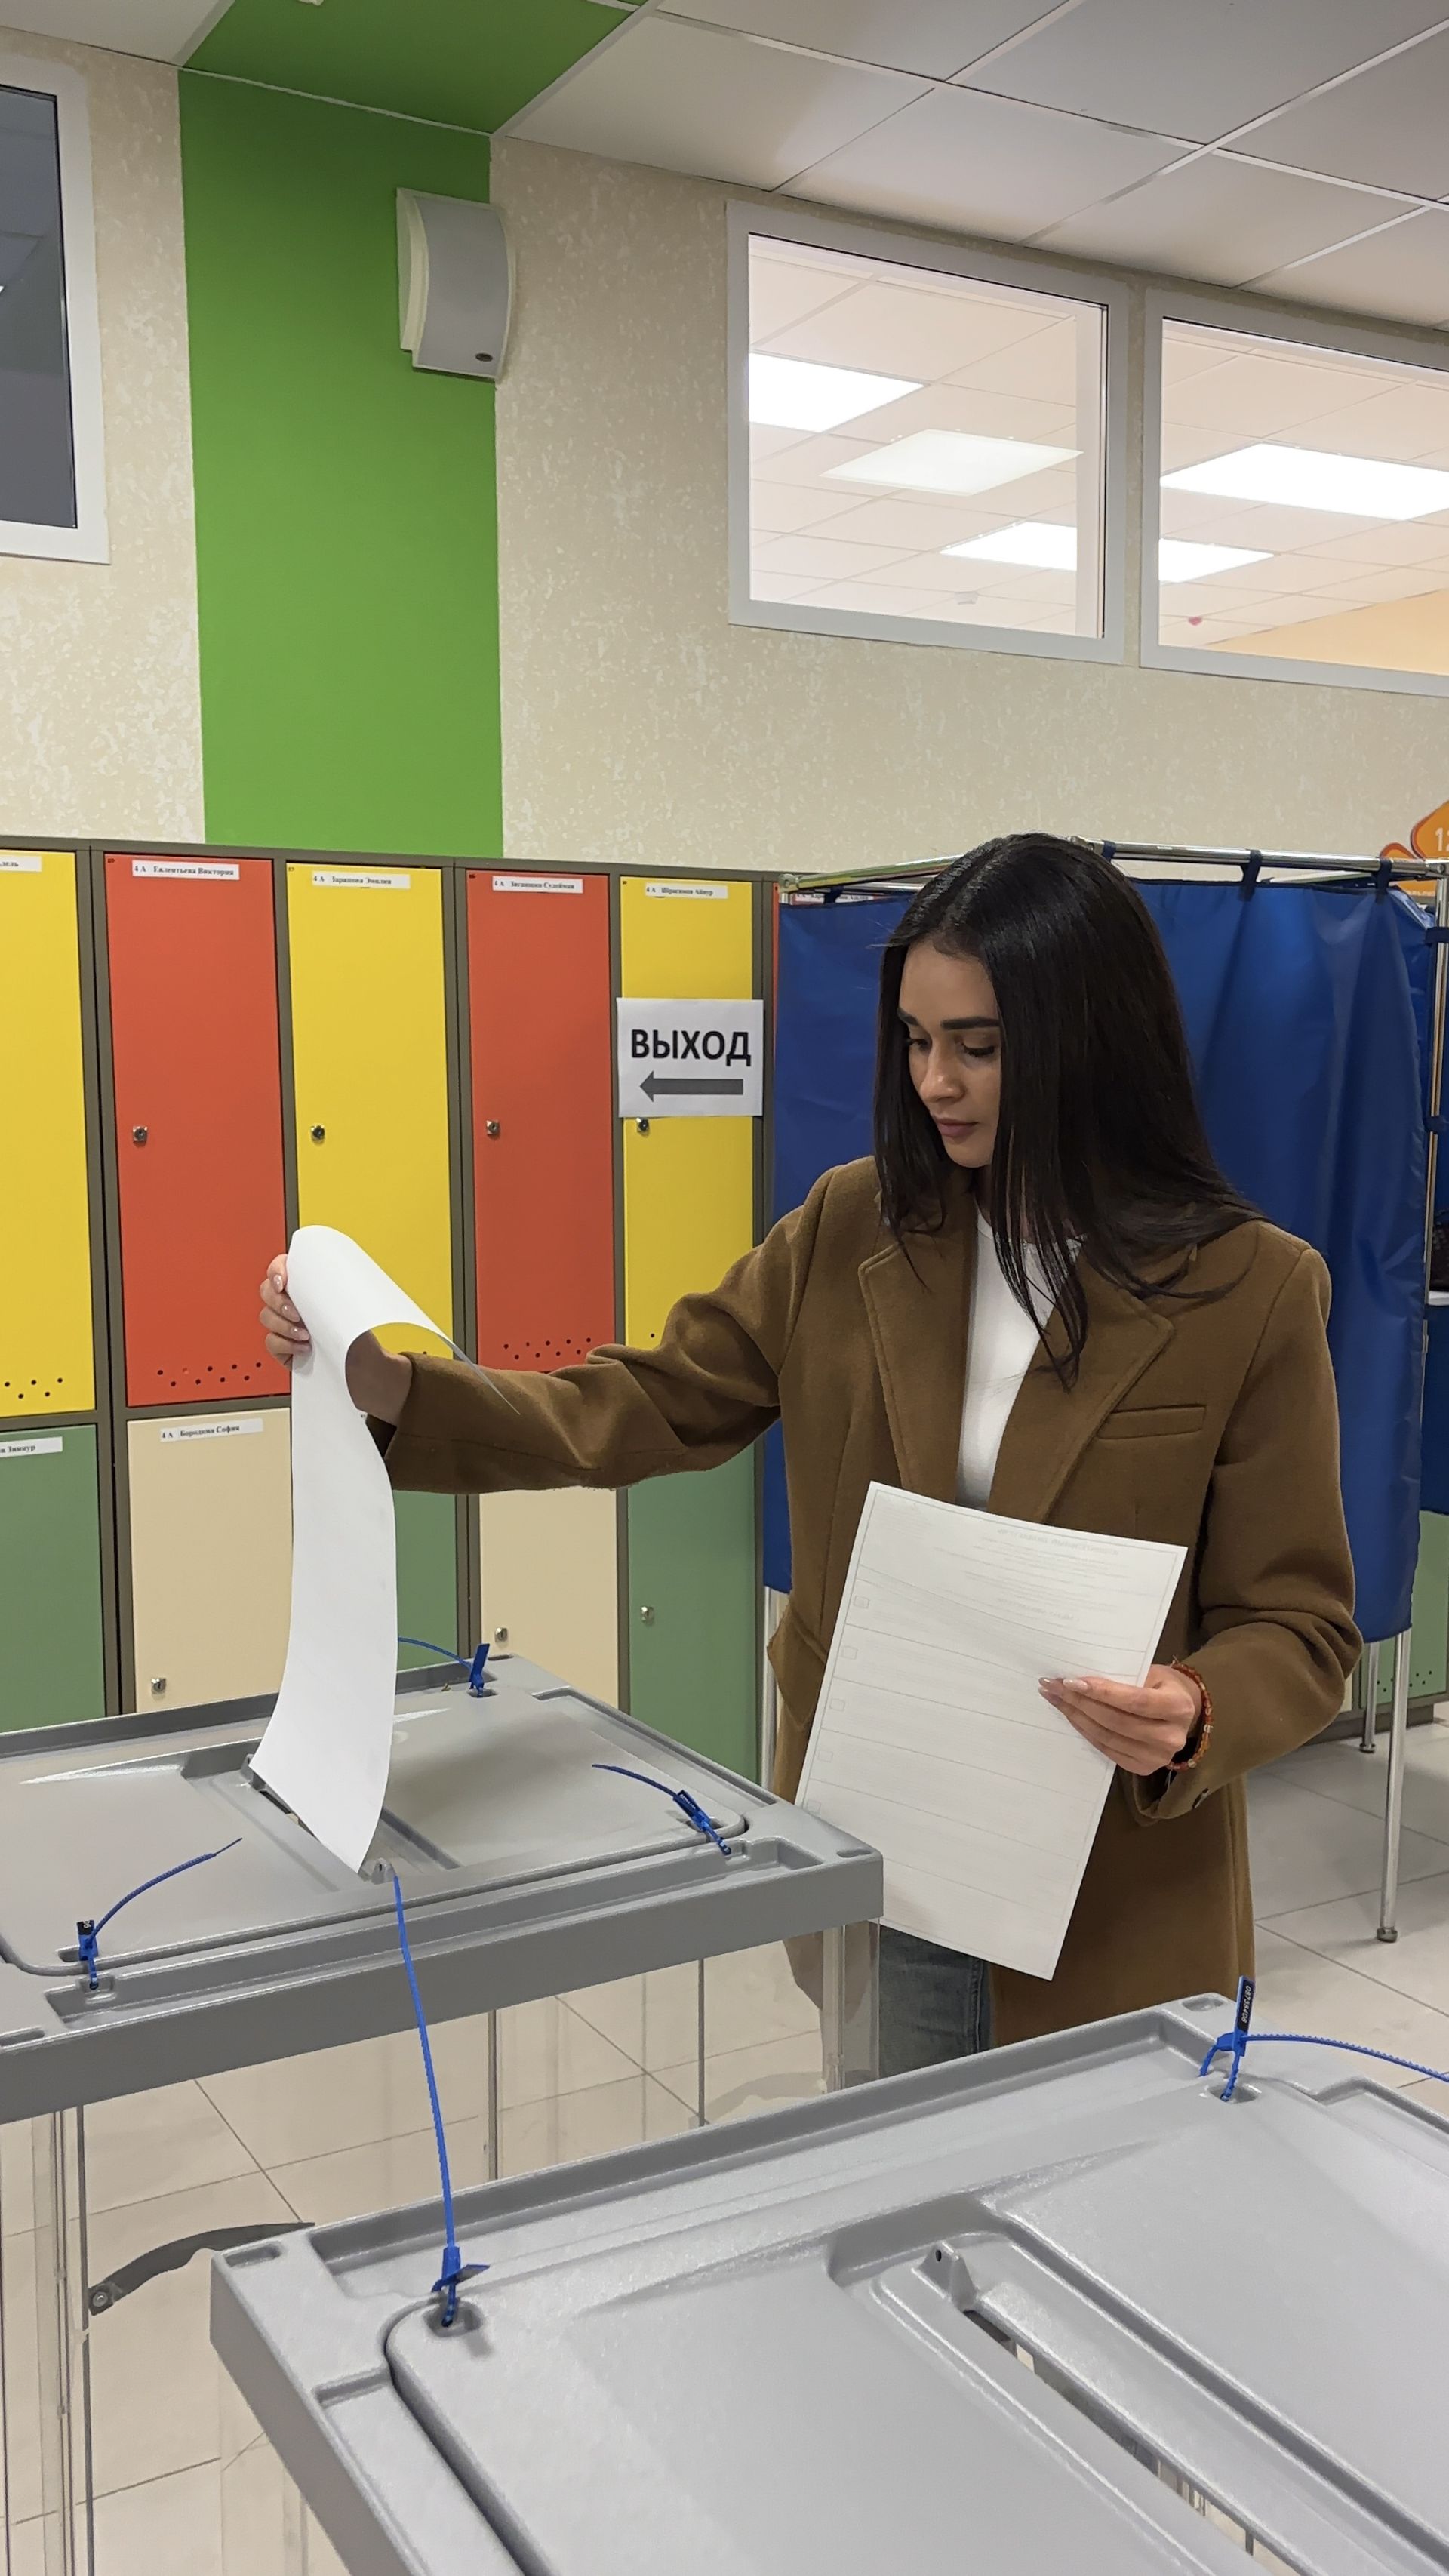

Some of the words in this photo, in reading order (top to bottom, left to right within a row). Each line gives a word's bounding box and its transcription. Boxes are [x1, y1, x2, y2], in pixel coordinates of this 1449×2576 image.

[198, 867, 234, 876] Виктория
[631, 1029, 752, 1067] ВЫХОД
[216, 1425, 240, 1433] София
